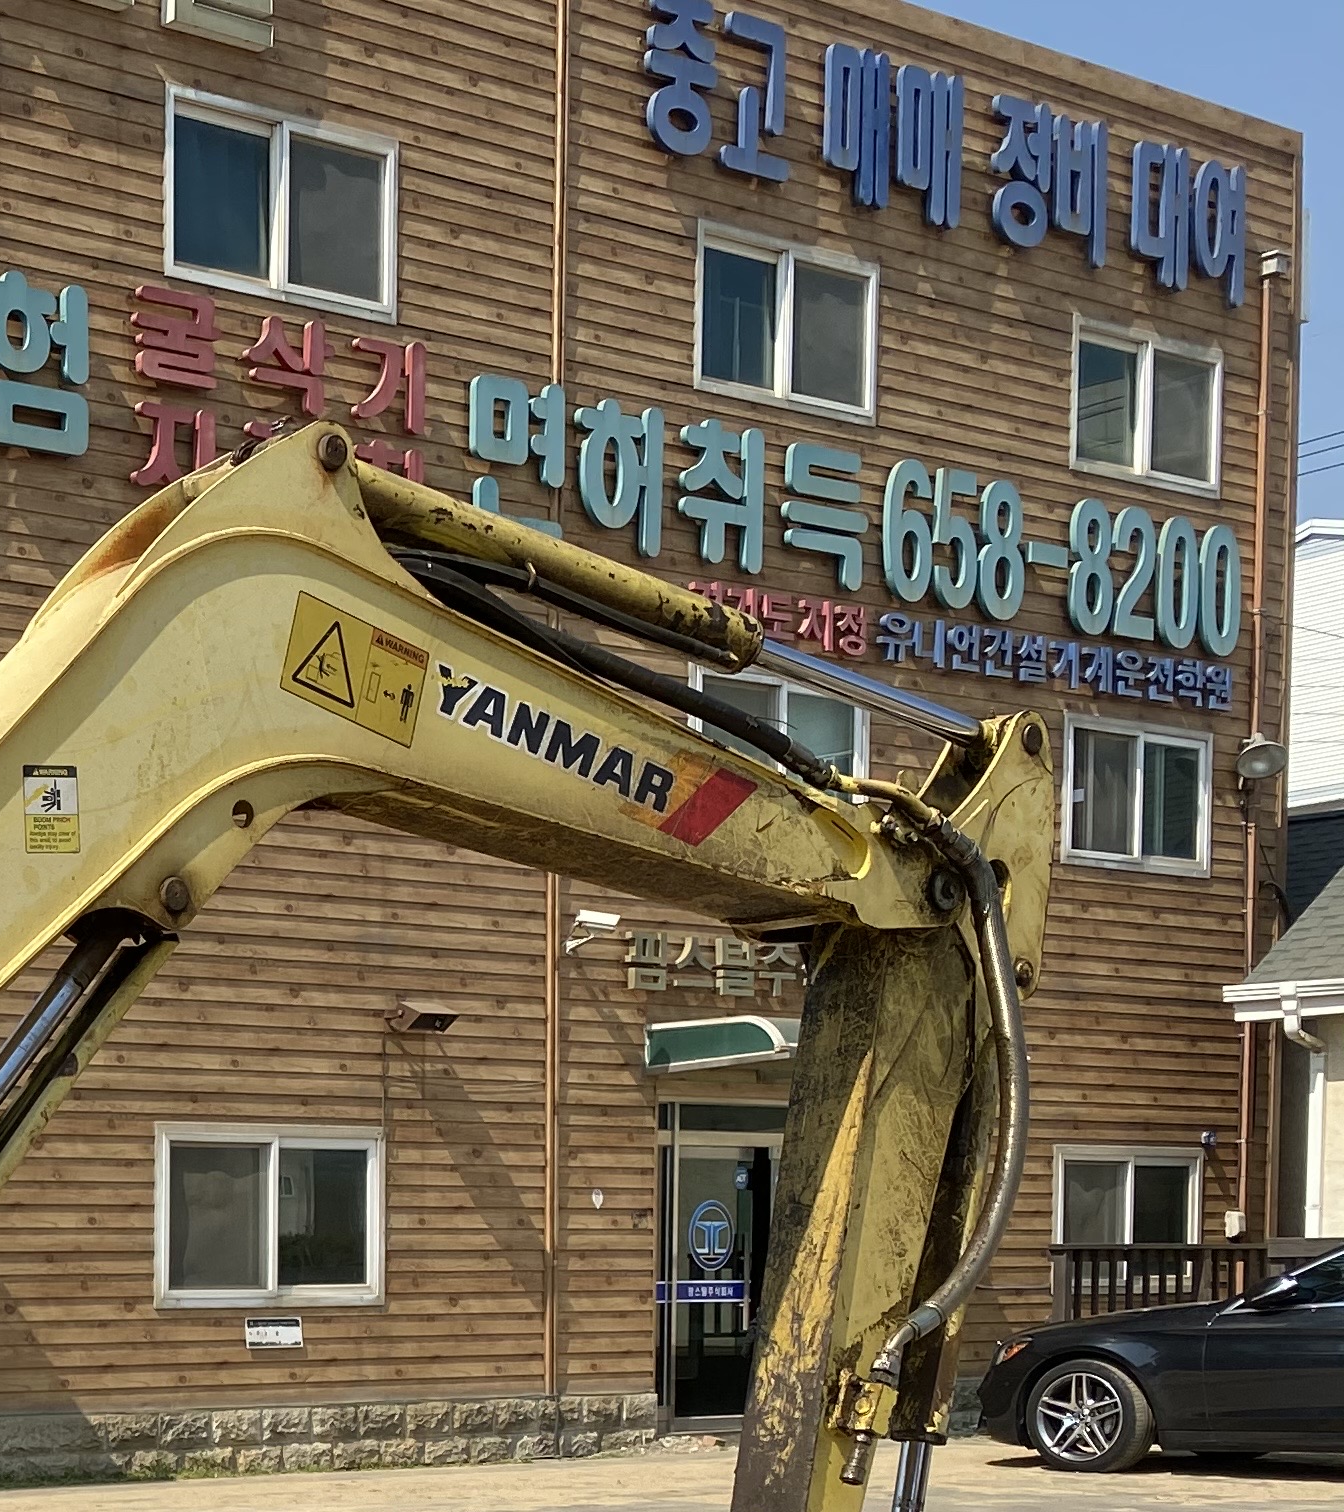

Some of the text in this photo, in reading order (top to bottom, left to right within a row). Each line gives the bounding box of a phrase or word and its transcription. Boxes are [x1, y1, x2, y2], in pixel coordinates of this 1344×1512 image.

[644, 0, 1246, 307] 중고 매매 정비 대여
[130, 285, 427, 435] 굴삭기
[883, 458, 1241, 657] 658-8200
[384, 637, 425, 664] WARNING
[437, 662, 675, 814] YANMAR
